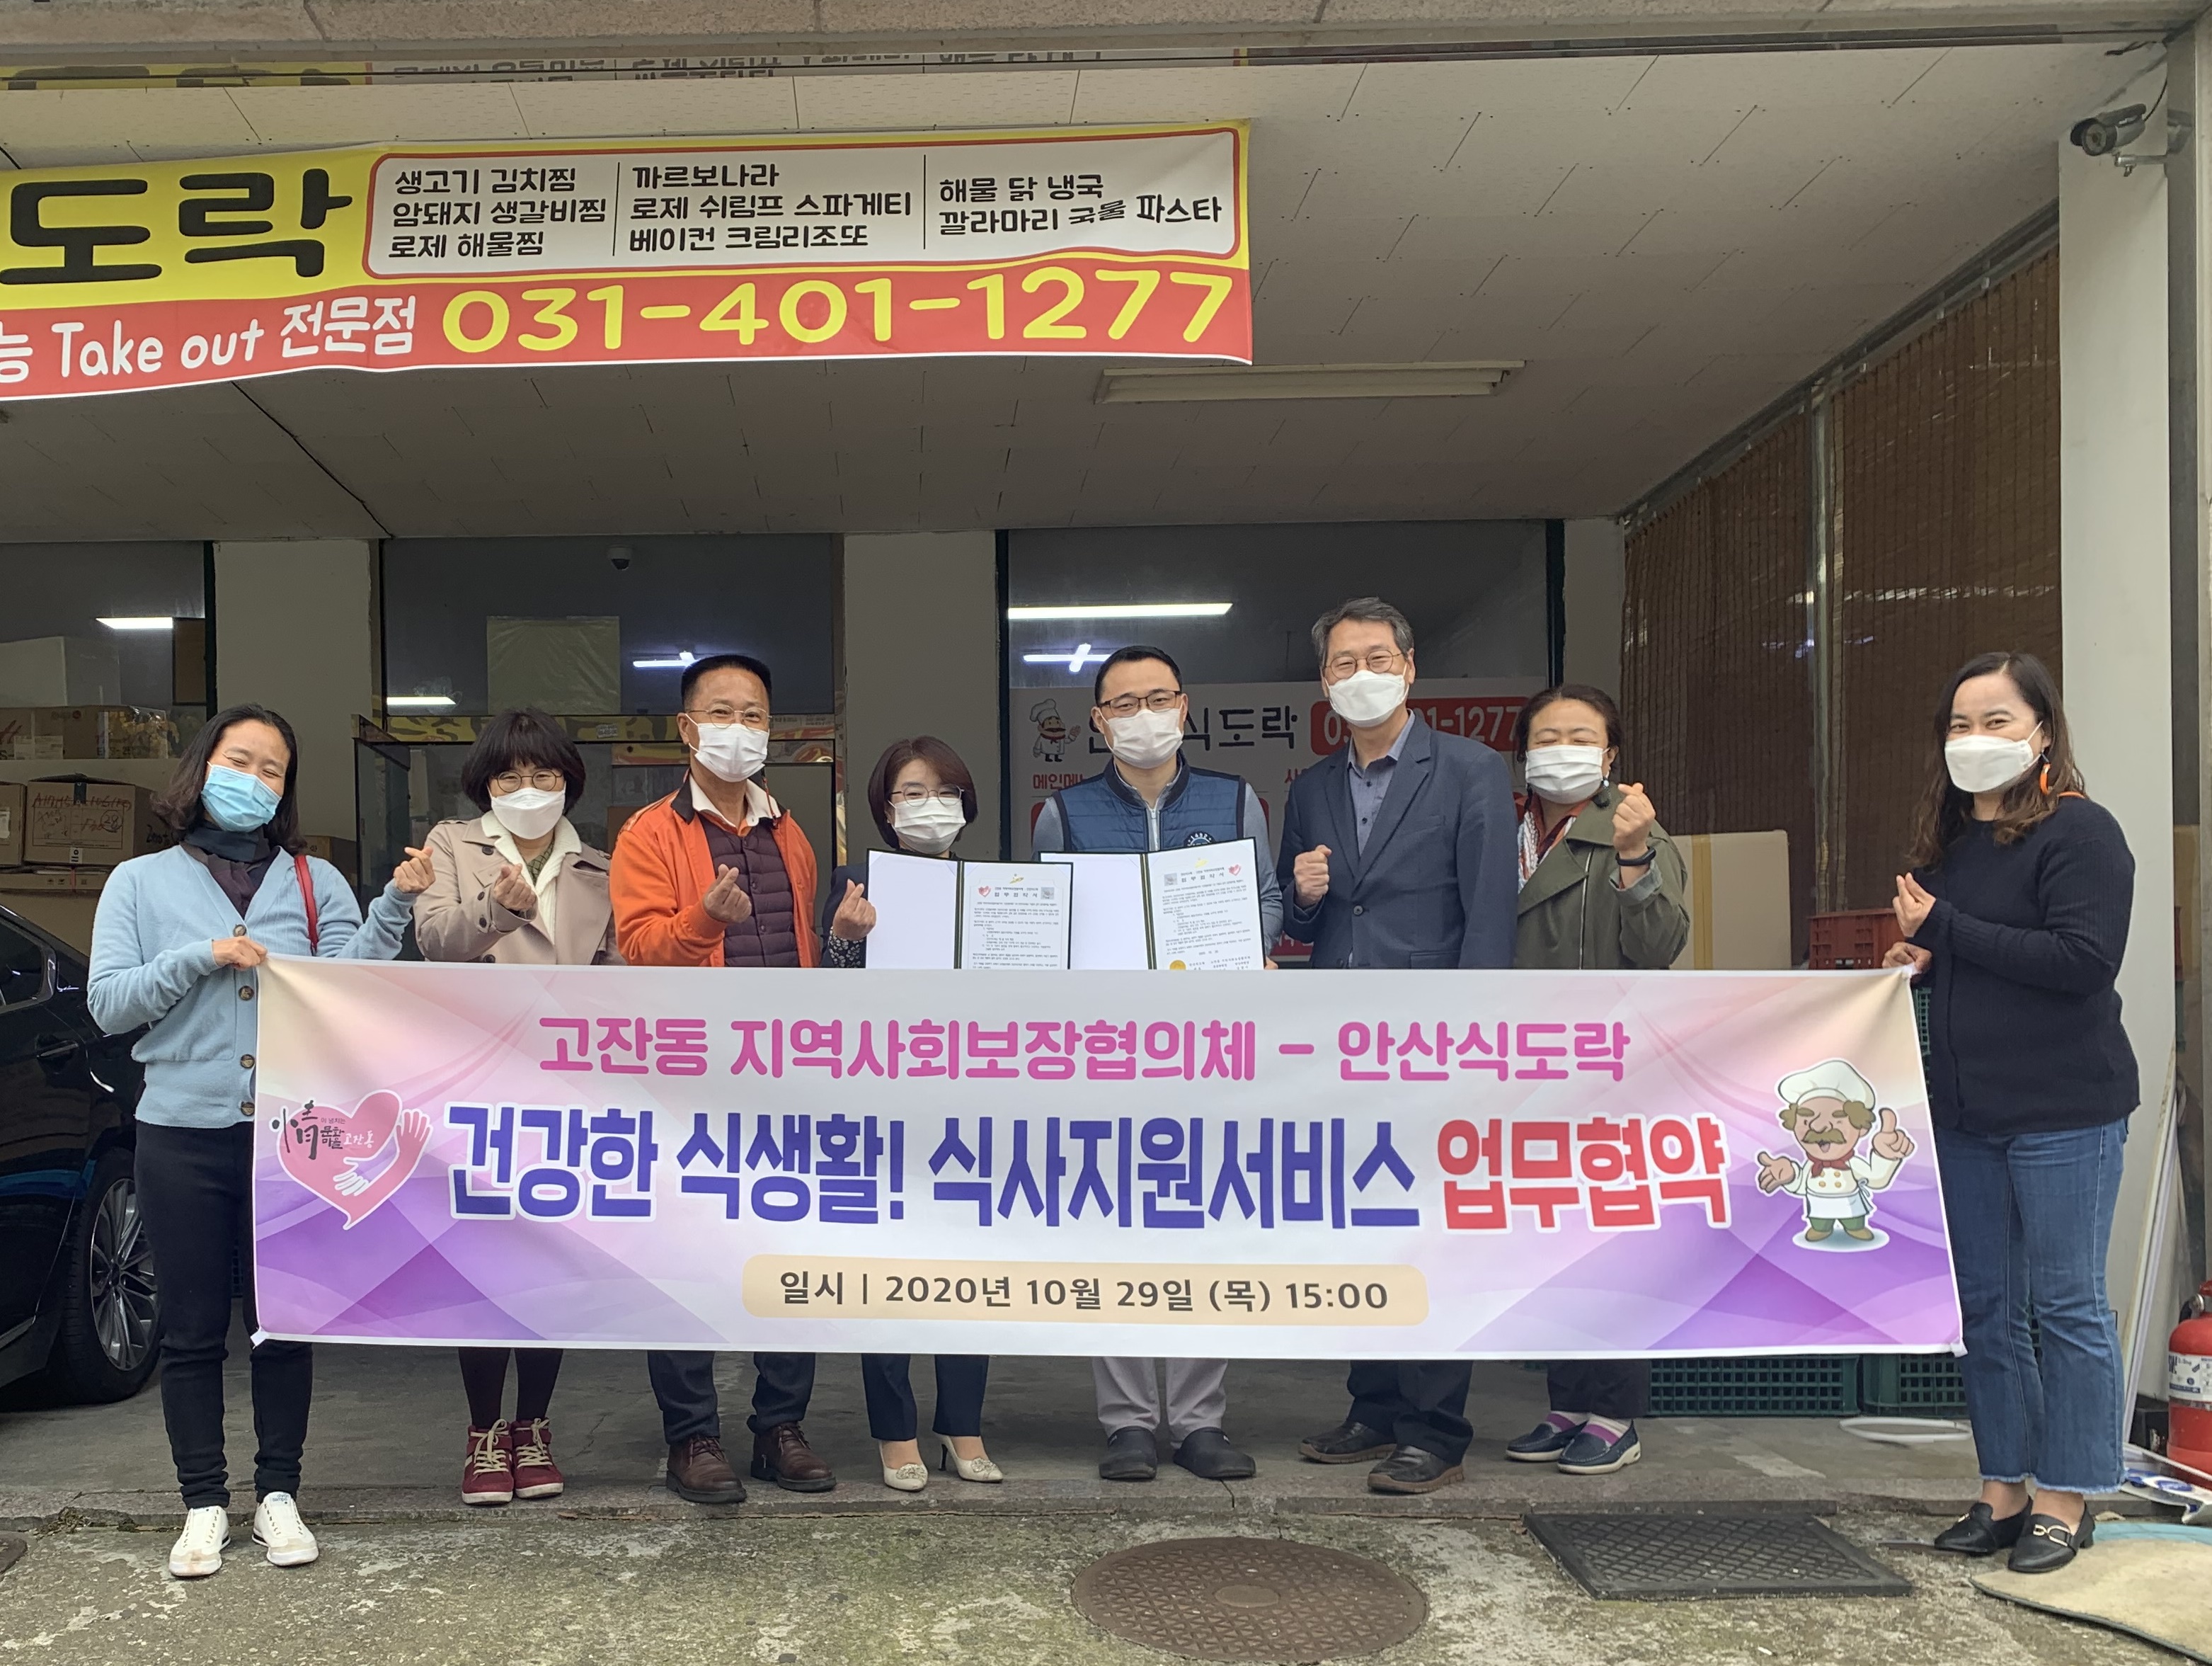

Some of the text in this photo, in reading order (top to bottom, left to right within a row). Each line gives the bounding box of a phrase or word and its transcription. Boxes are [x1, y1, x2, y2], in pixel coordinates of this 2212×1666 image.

[394, 167, 576, 195] 생고기 김치찜
[631, 163, 780, 190] 까르보나라
[939, 174, 1104, 203] 해물 닭 냉국
[393, 198, 607, 227] 암돼지 생갈비찜
[630, 191, 911, 220] 로제 쉬림프 스파게티
[939, 208, 1058, 236] 깔라마리
[1135, 193, 1222, 224] 파스타
[0, 169, 353, 285] 도락
[388, 231, 544, 258] 로제 해물찜
[629, 224, 869, 252] 베이컨 크림리조또
[280, 295, 416, 358] 전문점
[443, 266, 1233, 356] 031-401-1277
[51, 319, 264, 377] Take out
[1089, 706, 1298, 755] 식도락
[539, 1017, 708, 1076] 고잔동
[730, 1019, 1255, 1080] 지역사회보장협의체
[1339, 1022, 1631, 1082] 안산식도락
[343, 1130, 374, 1148] 고잔동
[449, 1106, 1726, 1230] 건강한 식생활! 식사지원서비스 업무협약
[780, 1271, 1387, 1312] 일시 2020년 10월 29일 (목) 15:00
